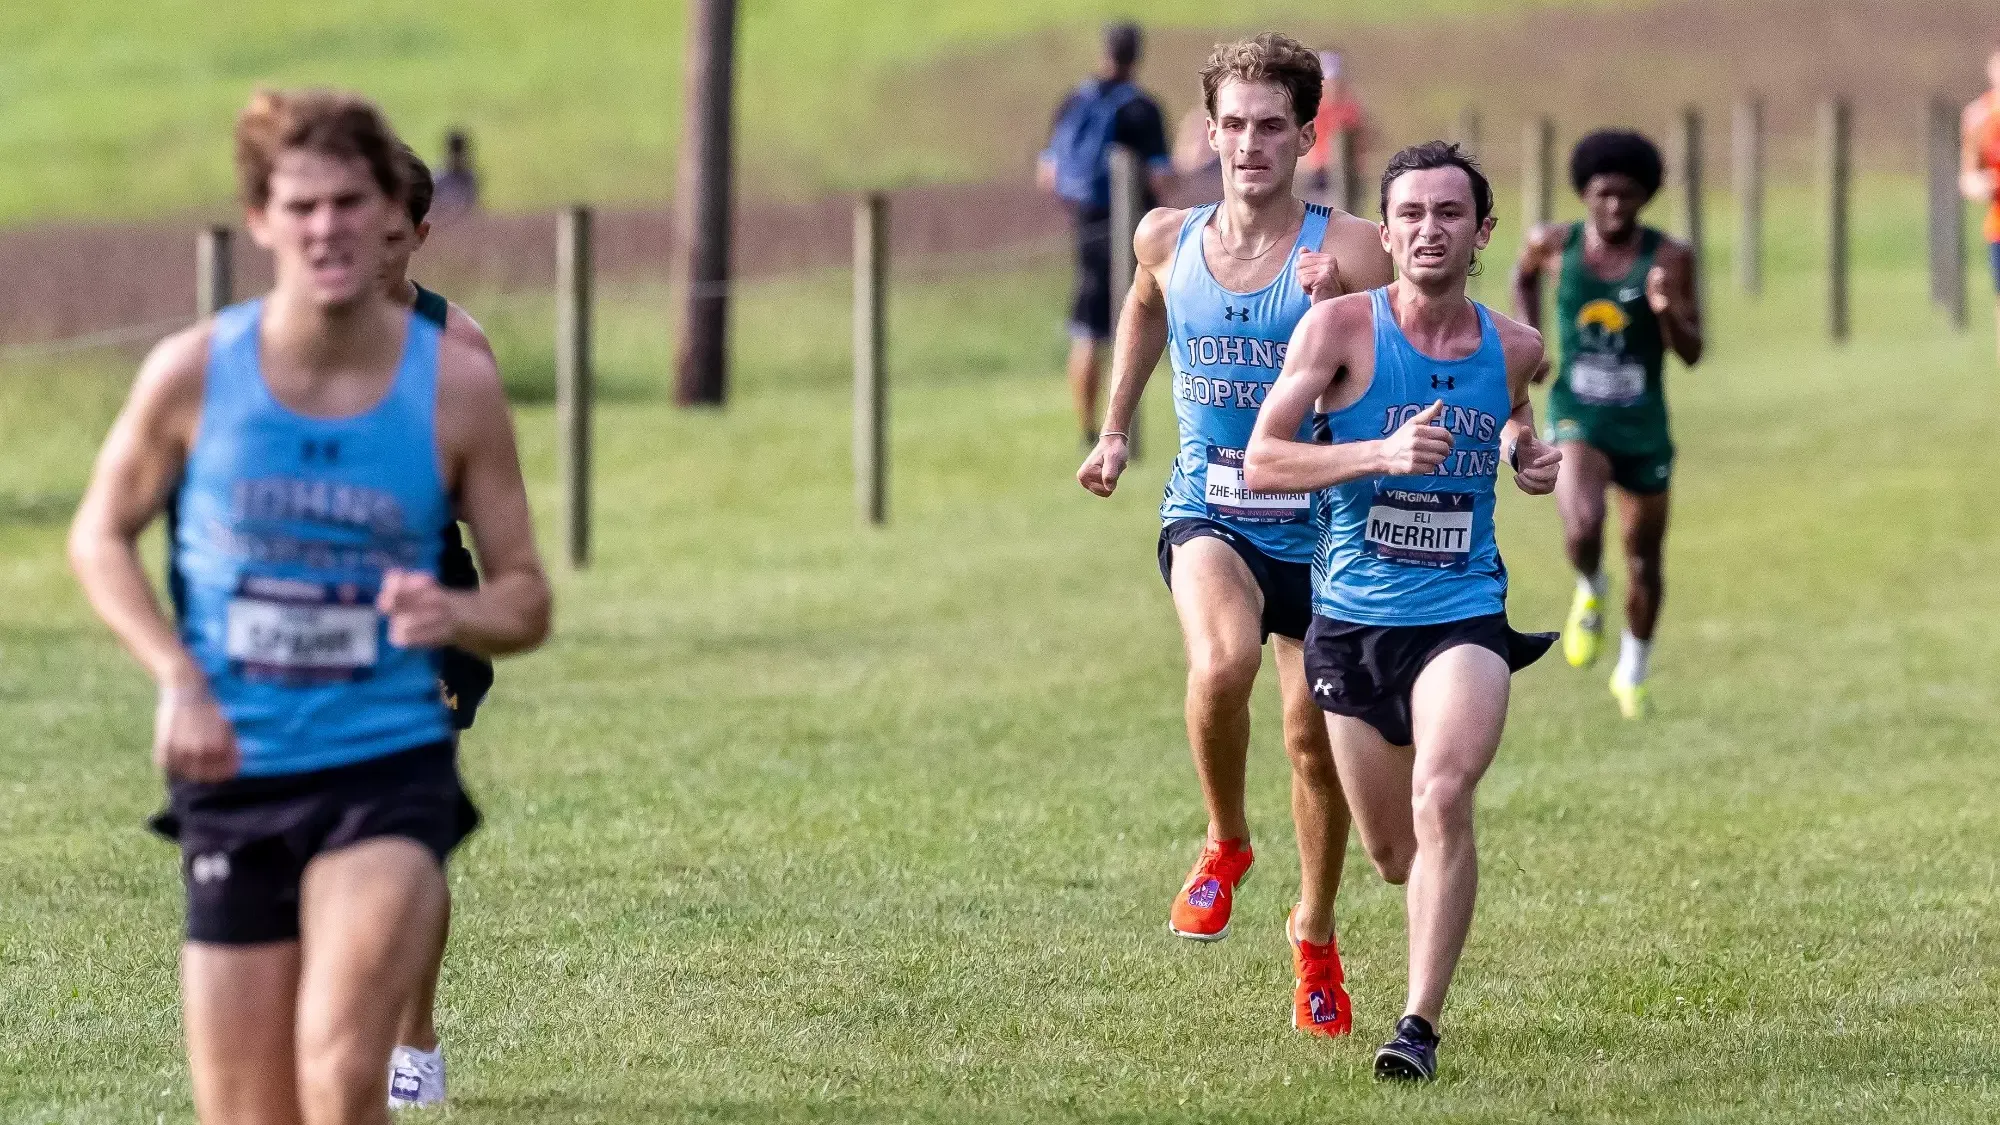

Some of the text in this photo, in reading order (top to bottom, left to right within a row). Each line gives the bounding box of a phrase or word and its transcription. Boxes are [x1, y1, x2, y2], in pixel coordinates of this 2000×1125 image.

[1187, 336, 1288, 369] JOHNS
[1209, 485, 1306, 500] ZHE-HEIMERMAN
[1387, 490, 1440, 503] VIRGINIA
[1414, 512, 1431, 523] ELI
[1371, 519, 1467, 548] MERRITT
